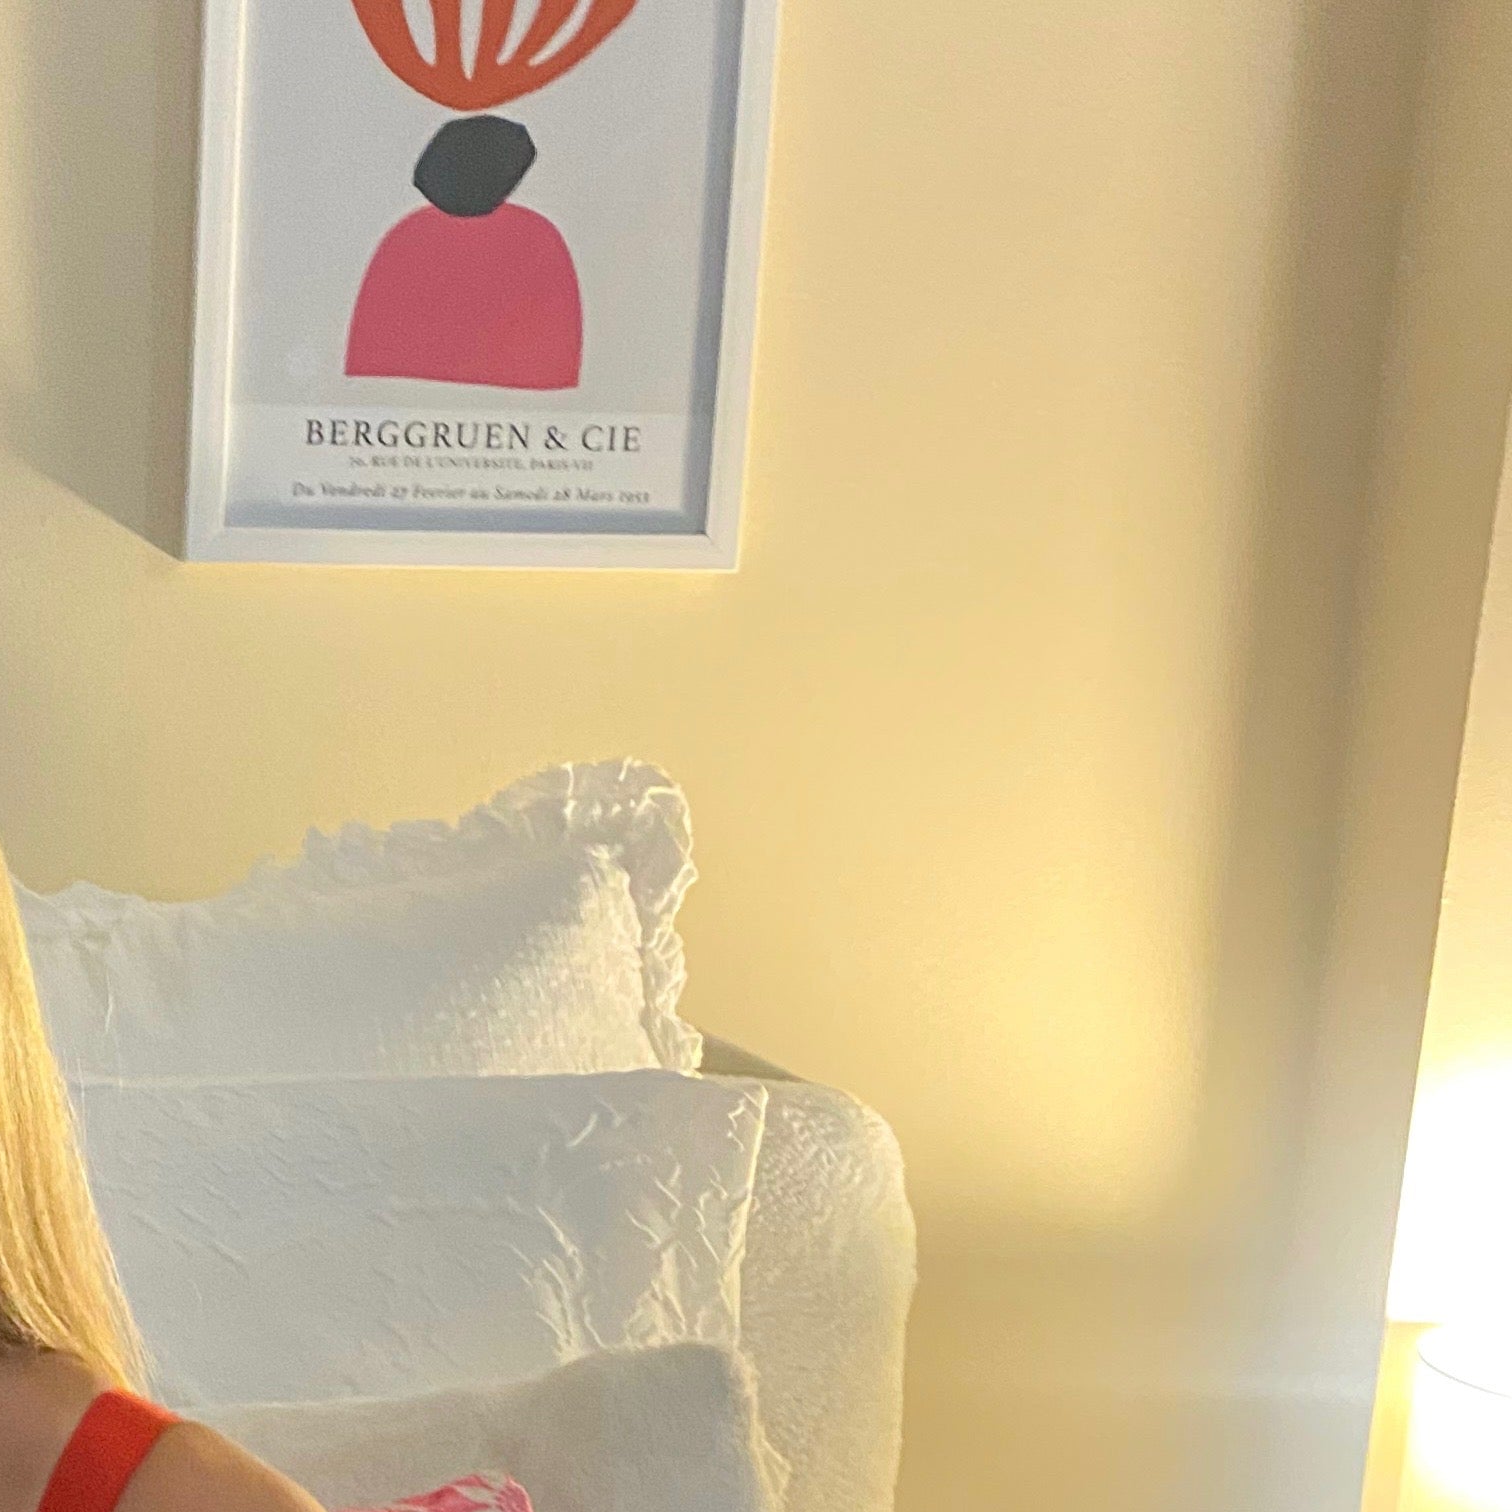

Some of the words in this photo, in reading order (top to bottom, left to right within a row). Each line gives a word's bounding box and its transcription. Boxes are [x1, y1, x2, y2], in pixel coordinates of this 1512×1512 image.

[305, 418, 531, 452] BERGGRUEN
[545, 426, 566, 452] &
[581, 424, 643, 453] CIE
[292, 481, 315, 496] Du
[320, 481, 387, 498] Vendredi
[494, 484, 548, 500] Samedi
[576, 486, 613, 501] Mars
